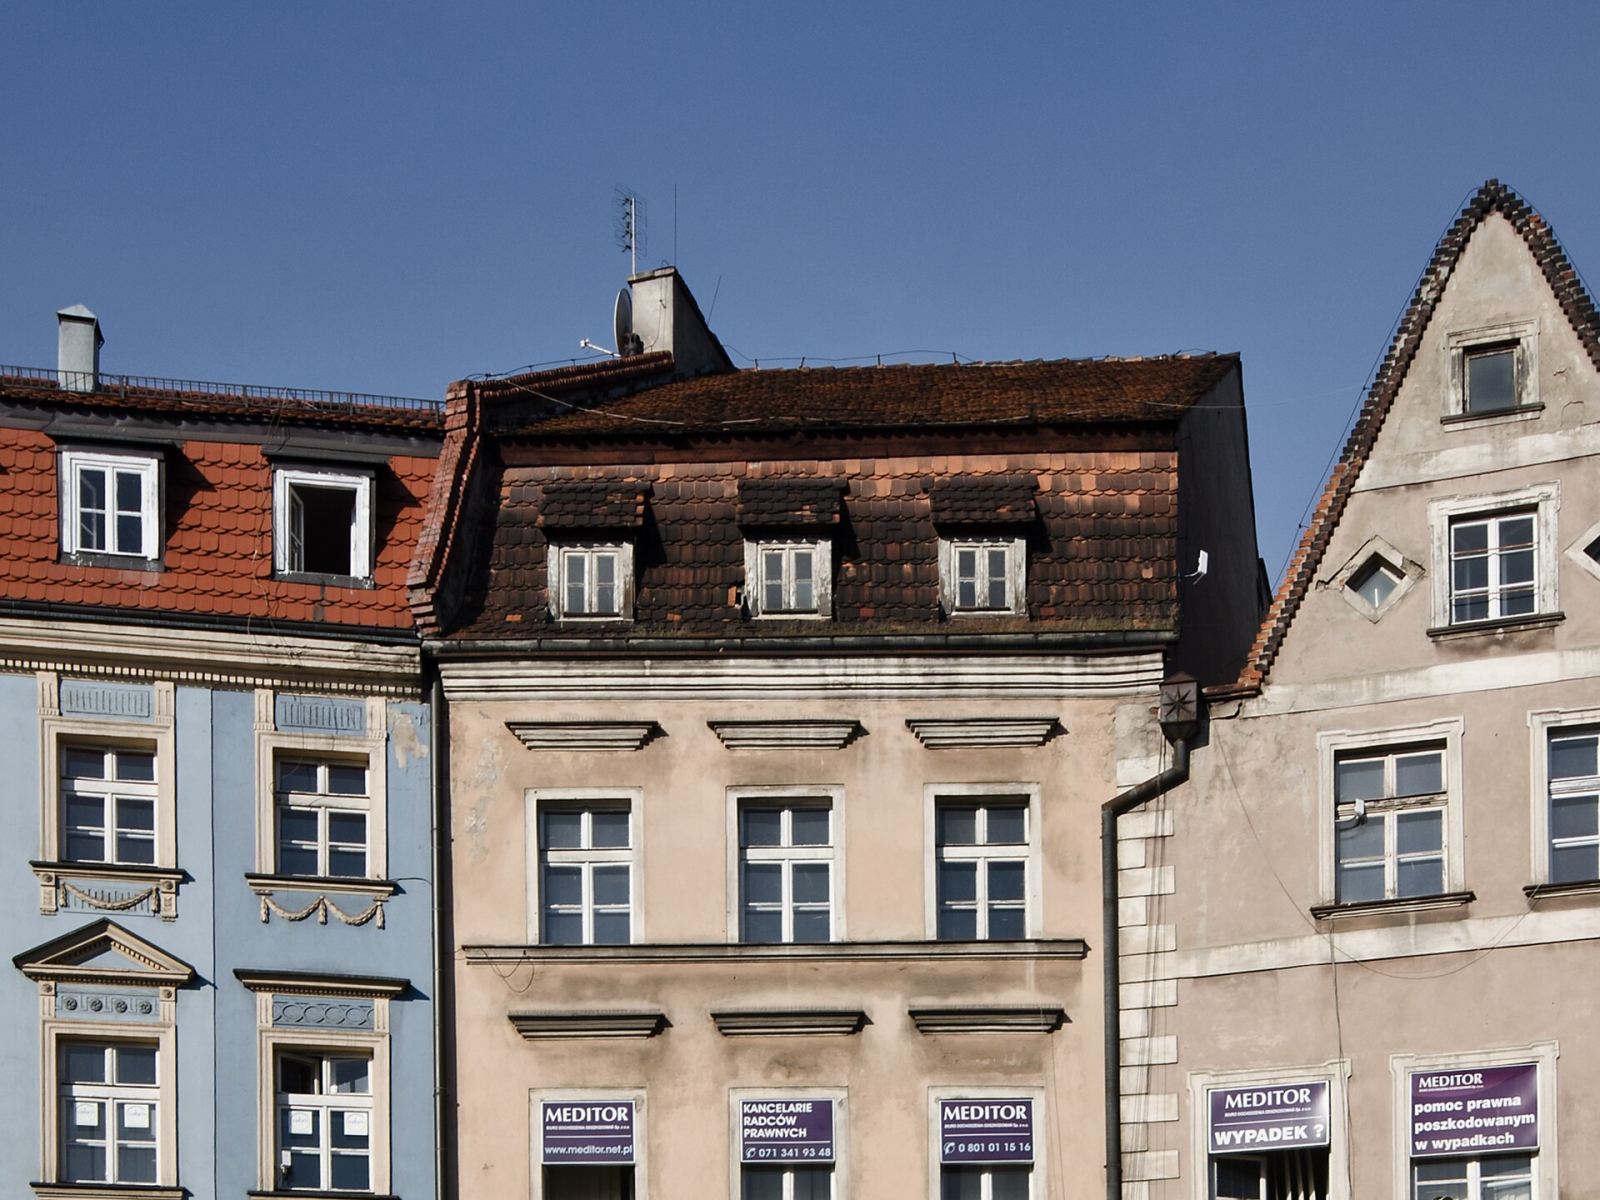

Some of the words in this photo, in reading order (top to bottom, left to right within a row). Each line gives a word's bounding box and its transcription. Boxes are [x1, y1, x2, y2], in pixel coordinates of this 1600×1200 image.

[1419, 1073, 1483, 1088] MEDITOR
[1225, 1088, 1312, 1109] MEDITOR
[1414, 1101, 1463, 1116] pomoc
[1467, 1096, 1521, 1112] prawna
[545, 1107, 629, 1122] MEDITOR
[743, 1103, 813, 1114] KANCELARIE
[944, 1105, 1027, 1120] MEDITOR
[743, 1113, 797, 1126] RADCÓW
[1414, 1113, 1536, 1135] poszkodowanym
[743, 1128, 807, 1138] PRAWNYCH
[1214, 1125, 1308, 1146] WYPADEK
[1313, 1124, 1324, 1138] ?
[958, 1144, 965, 1152] 0
[967, 1143, 985, 1152] 801
[988, 1143, 1000, 1152] 01
[1004, 1143, 1016, 1152] 15
[1019, 1143, 1031, 1152] 16
[1415, 1141, 1428, 1150] w
[1432, 1132, 1515, 1151] wypadkach
[544, 1144, 633, 1155] www.meditor.net.pl
[758, 1148, 777, 1158] 071
[781, 1148, 799, 1157] 341
[802, 1148, 816, 1157] 93
[818, 1148, 831, 1157] 48
